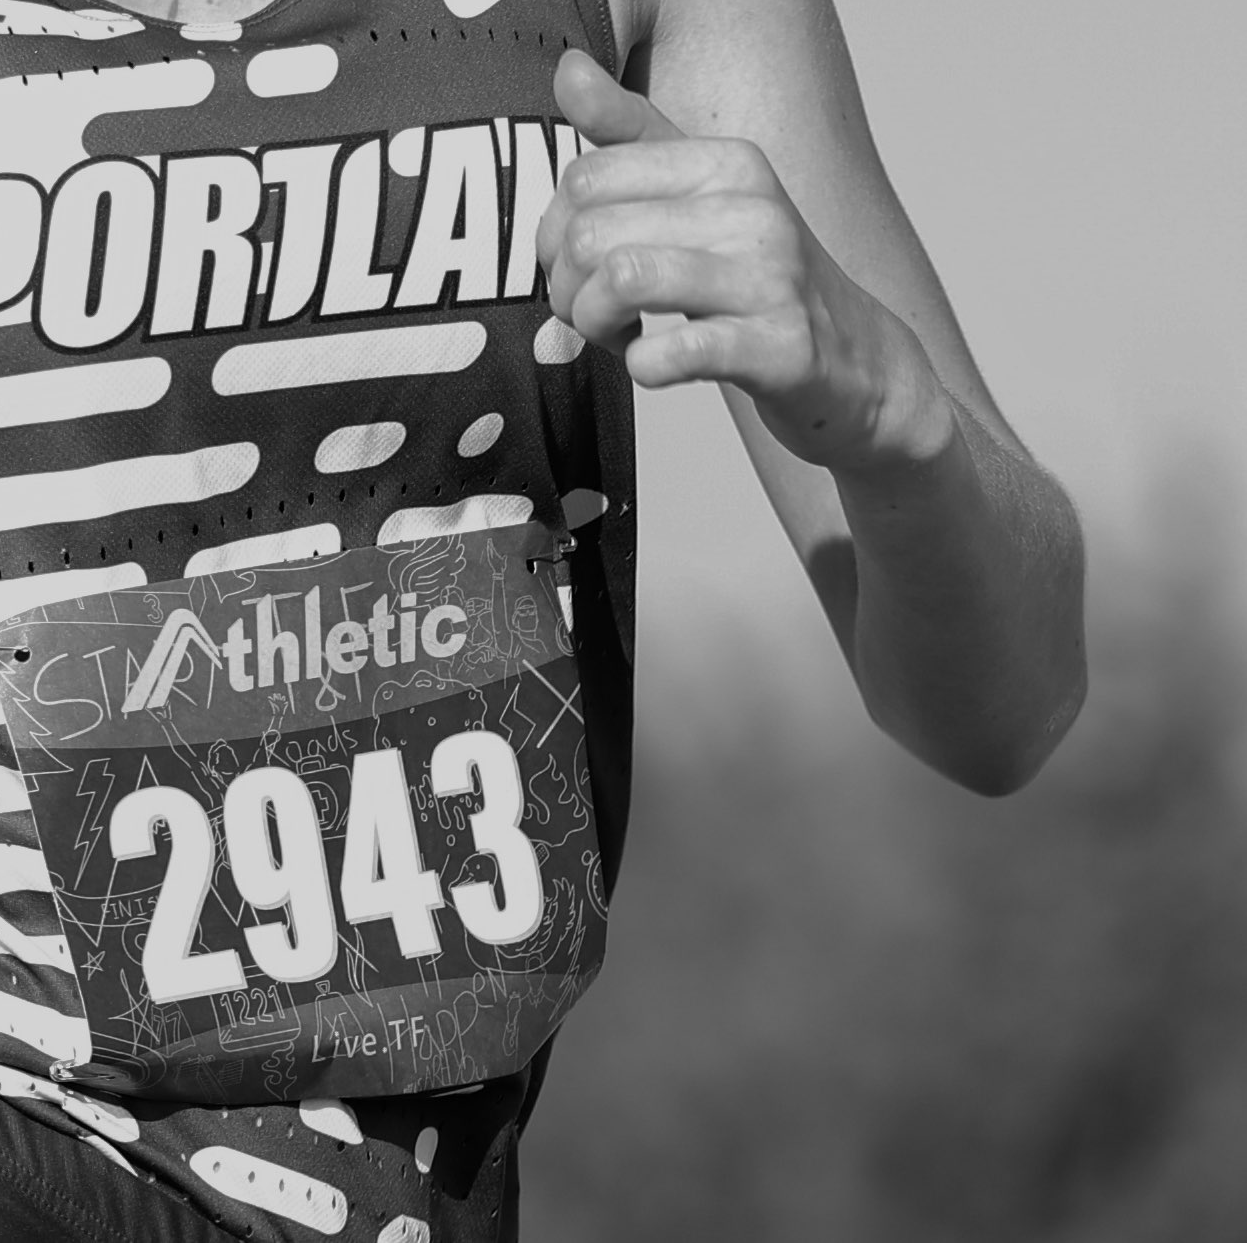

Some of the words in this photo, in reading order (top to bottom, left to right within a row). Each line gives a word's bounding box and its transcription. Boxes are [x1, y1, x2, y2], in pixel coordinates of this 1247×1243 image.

[120, 585, 468, 714] Athletic
[109, 729, 544, 1005] 2943
[101, 895, 159, 920] FINIS
[220, 984, 285, 1028] 1221
[312, 1015, 425, 1063] Live.TF
